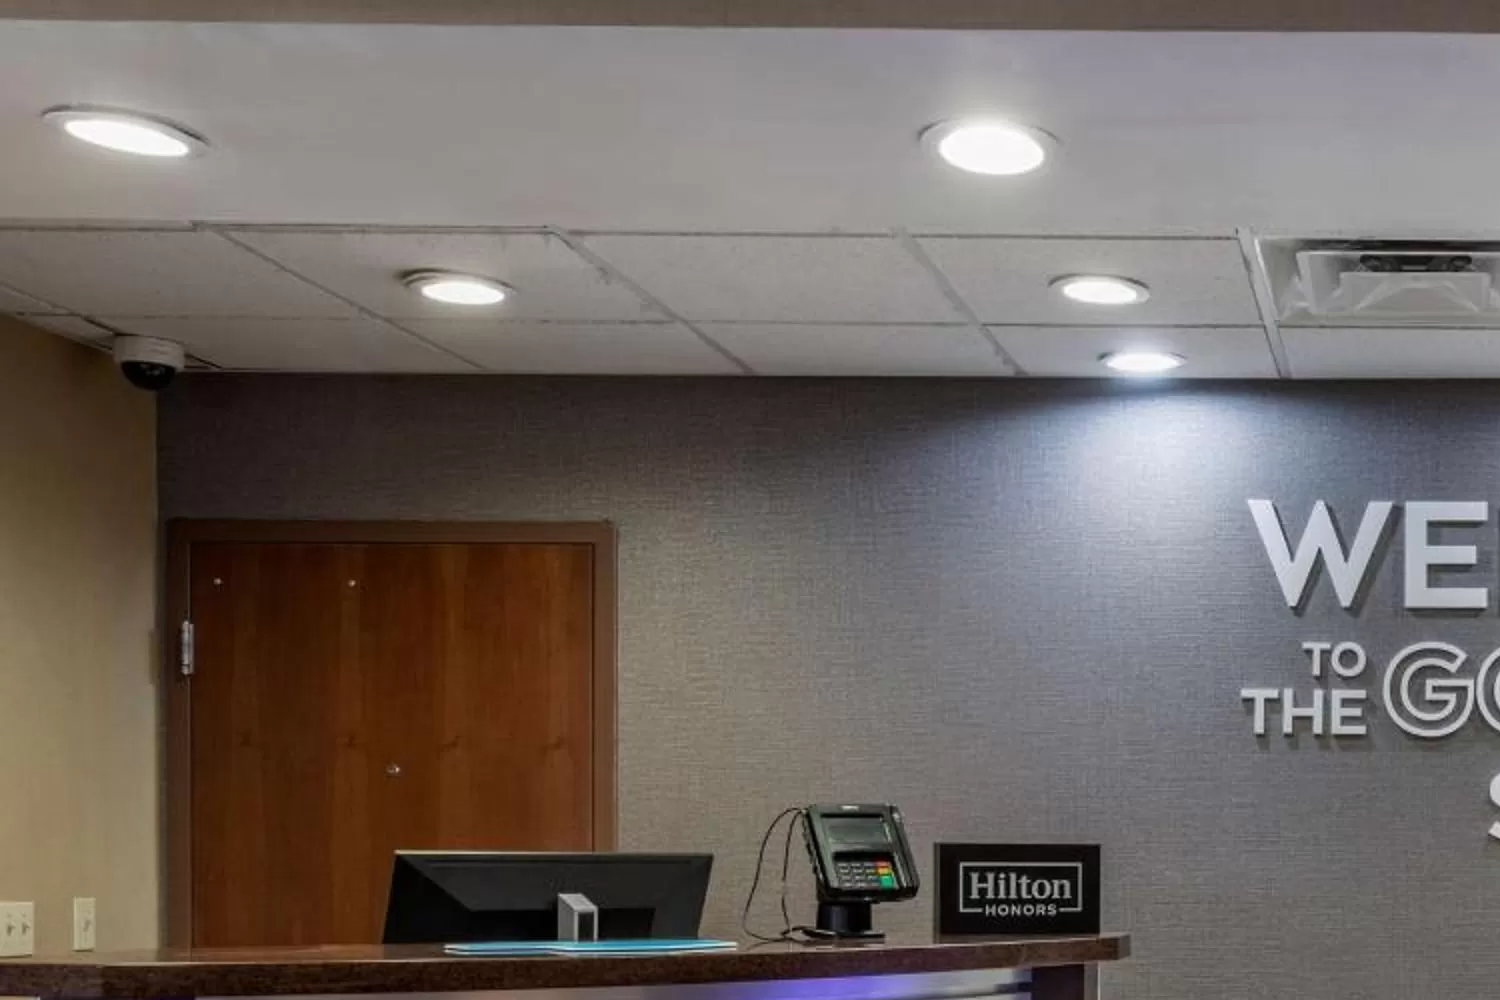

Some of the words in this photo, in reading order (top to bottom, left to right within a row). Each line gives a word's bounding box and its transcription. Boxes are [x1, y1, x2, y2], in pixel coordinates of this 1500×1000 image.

[1302, 641, 1367, 677] TO
[1241, 688, 1367, 736] THE
[970, 872, 1072, 899] Hilton
[985, 904, 1058, 917] HONORS
